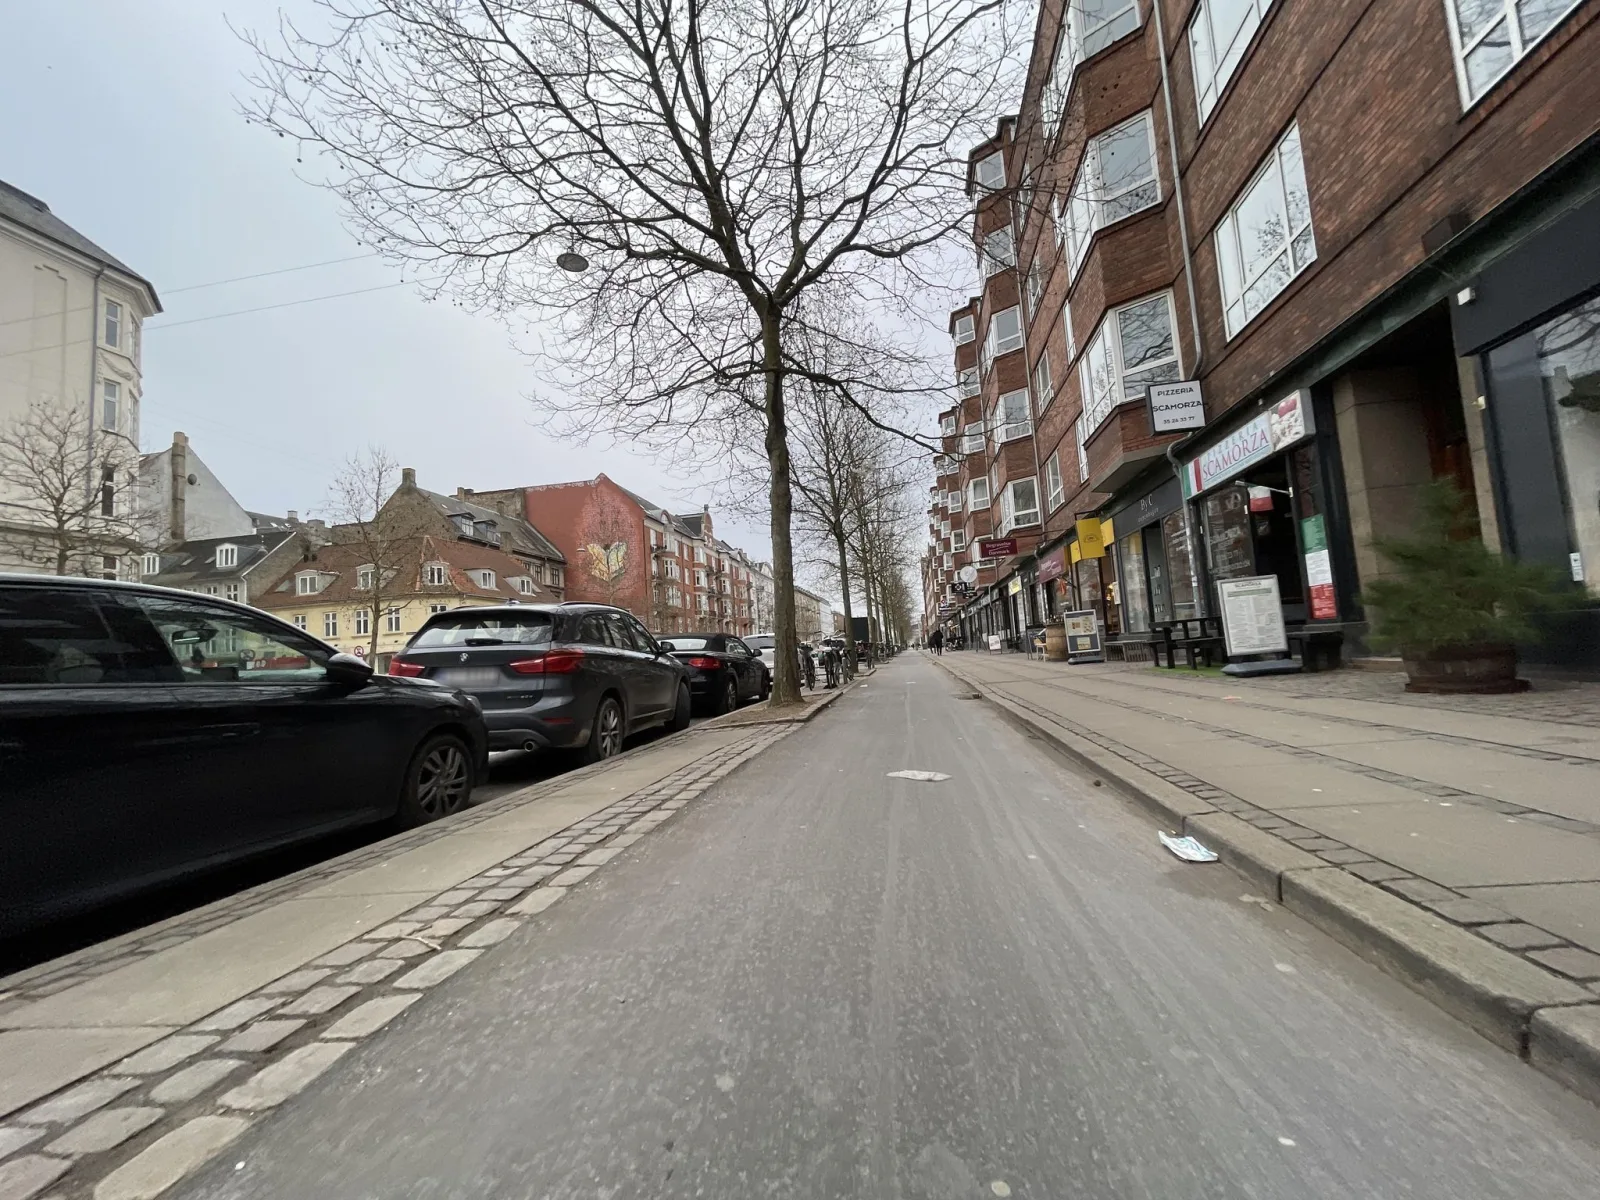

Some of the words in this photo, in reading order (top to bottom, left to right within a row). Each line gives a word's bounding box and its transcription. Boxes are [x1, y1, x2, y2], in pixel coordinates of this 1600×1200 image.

[1157, 387, 1194, 396] PIZZERIA
[1152, 400, 1203, 412] SCAMORZA
[1202, 428, 1269, 479] SCAMORZA
[1206, 422, 1259, 462] PIZZERIA
